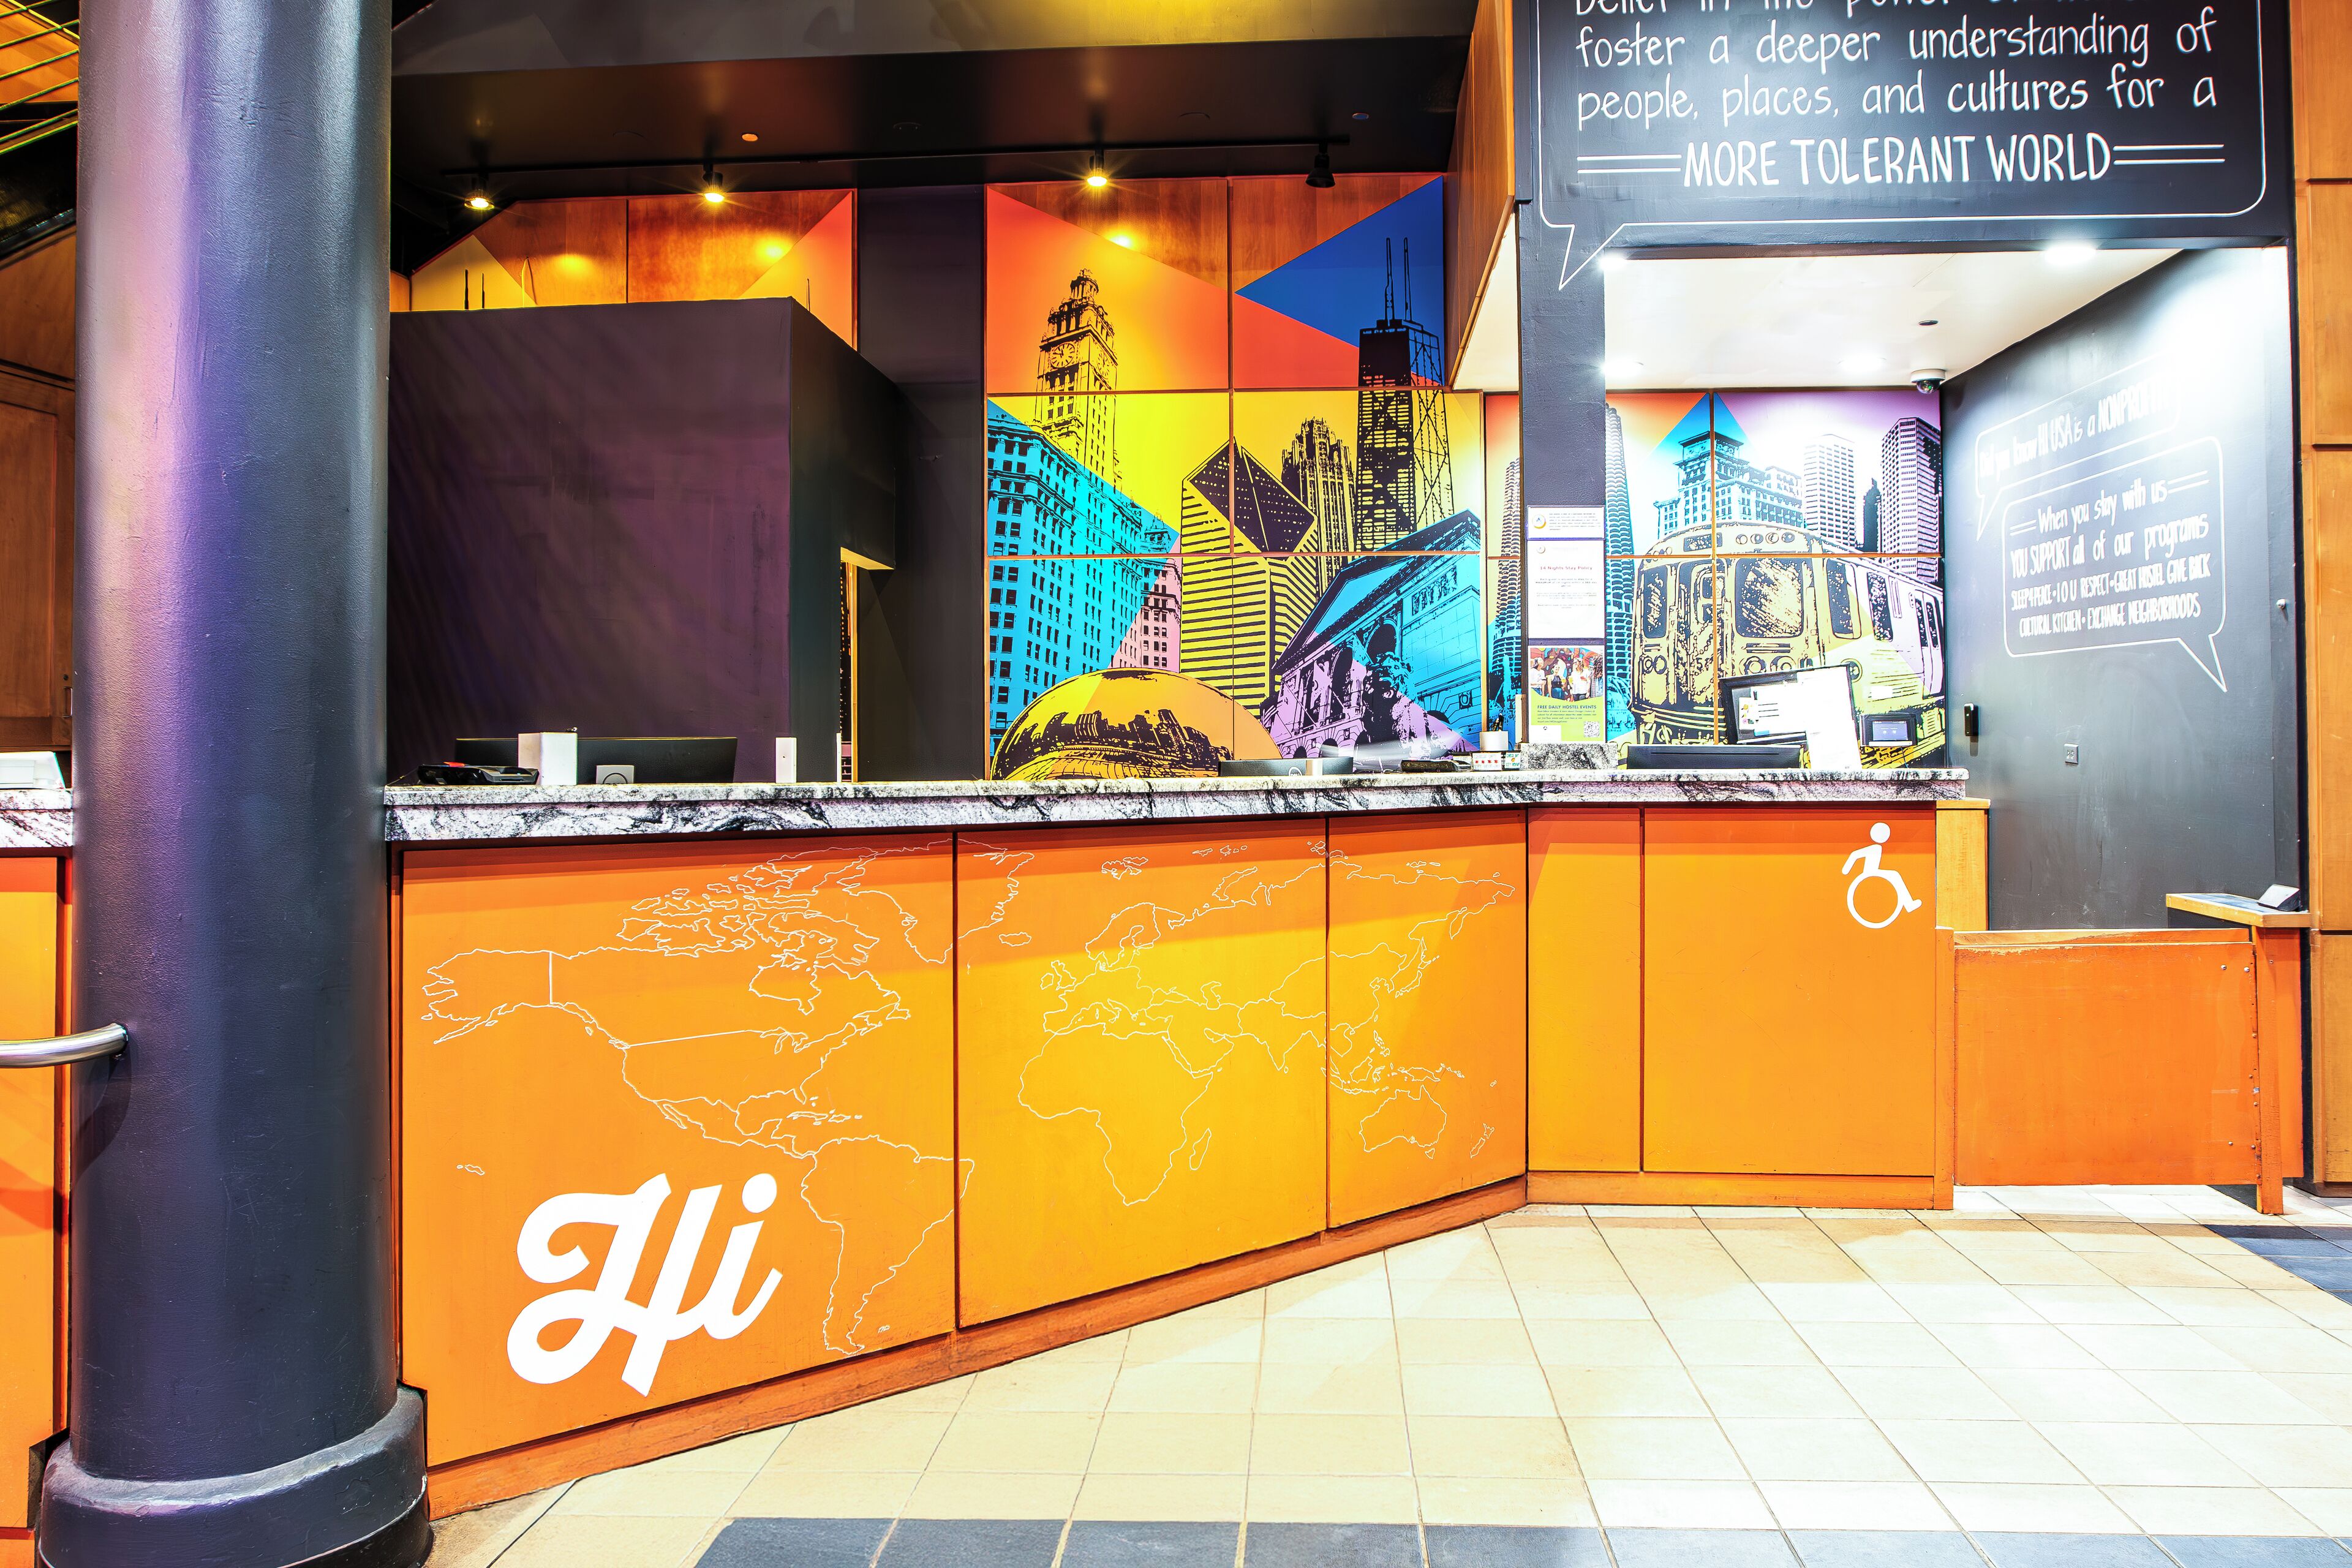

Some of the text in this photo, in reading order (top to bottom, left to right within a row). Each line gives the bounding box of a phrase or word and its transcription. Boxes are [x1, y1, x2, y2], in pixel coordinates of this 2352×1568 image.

[1575, 6, 2218, 74] foster a deeper understanding of
[1577, 62, 2217, 130] people, places, and cultures for a
[1683, 132, 2111, 187] MORE TOLERANT WORLD
[2038, 421, 2049, 456] HI
[2050, 412, 2073, 452] USA
[2073, 416, 2084, 442] is
[2087, 414, 2096, 437] a
[2038, 478, 2168, 534] When you stay with us
[2010, 513, 2209, 579] YOU SUPPORT all of our programs
[2080, 572, 2111, 598] RESPECT
[2114, 568, 2138, 594] GREAT
[2138, 562, 2165, 589] HOSTEL
[2166, 557, 2188, 584] GIVE
[2188, 552, 2211, 581] BACK
[2019, 592, 2202, 638] CULTURAL KITCHEN EXCHANGE NEIGHBORHOODS
[507, 1172, 783, 1398] Hi
